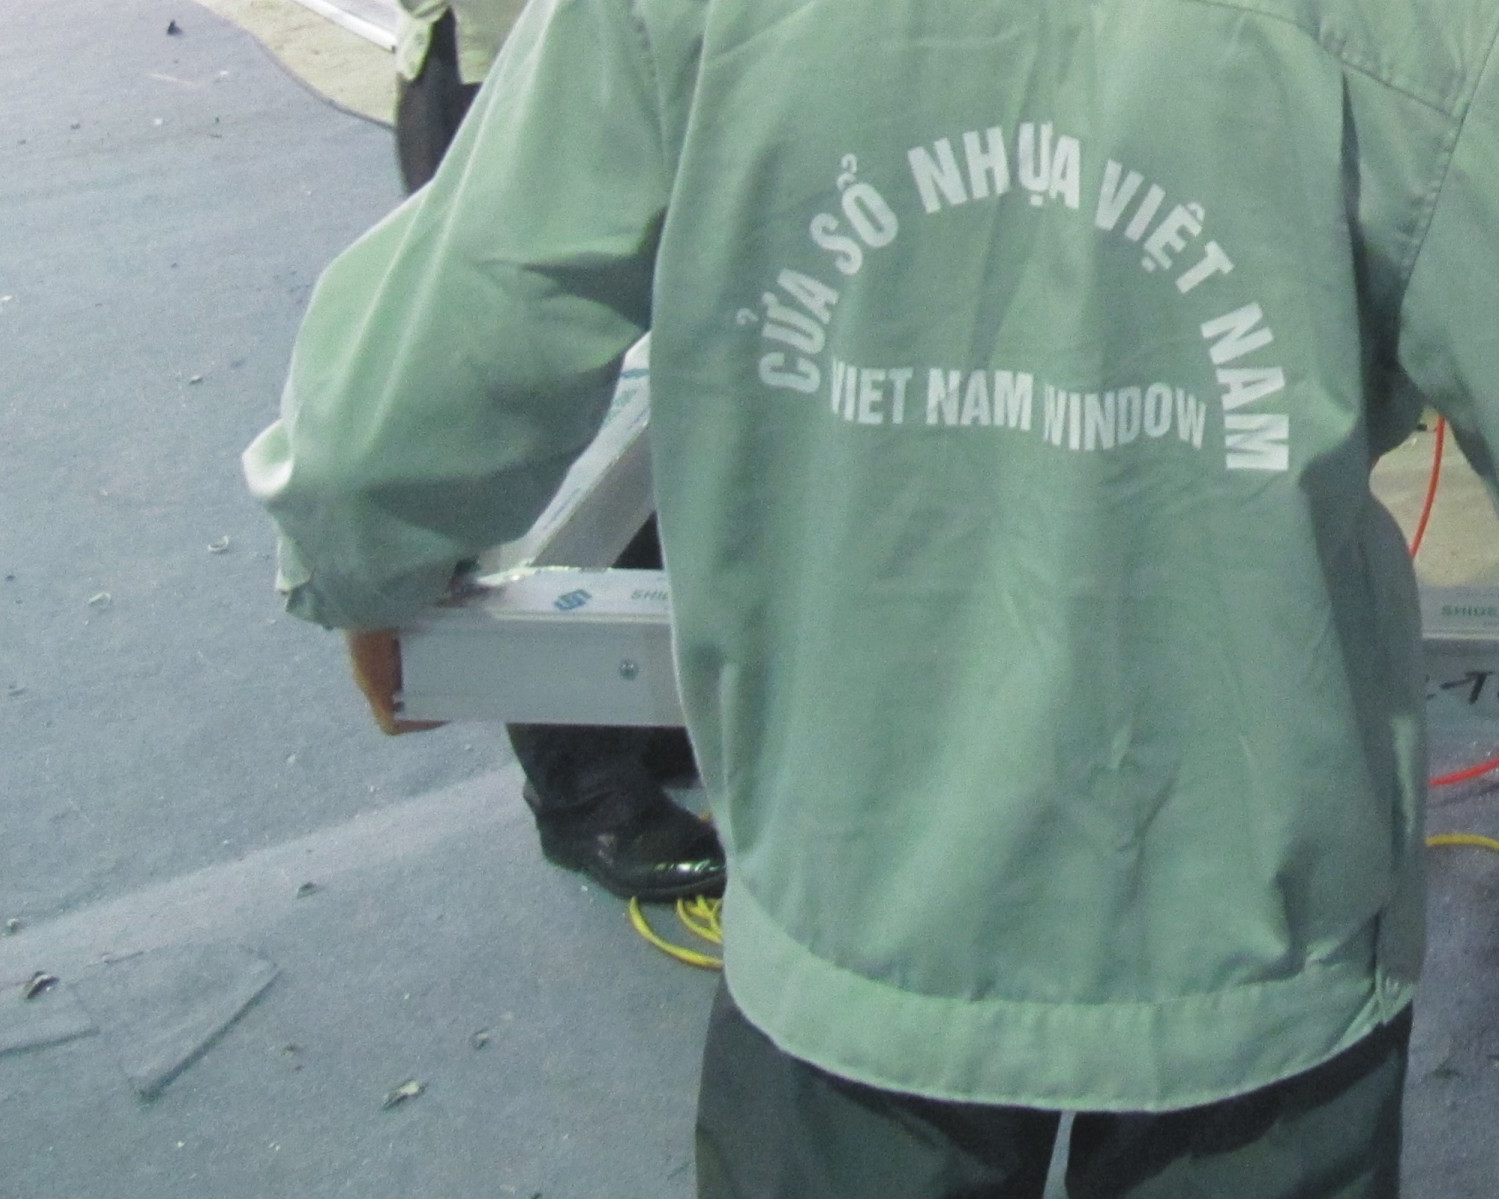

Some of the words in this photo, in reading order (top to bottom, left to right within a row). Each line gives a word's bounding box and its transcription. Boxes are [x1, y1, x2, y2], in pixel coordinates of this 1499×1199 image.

[735, 267, 840, 394] CỬA
[808, 152, 900, 276] SỔ
[906, 120, 1081, 215] NHỰA
[1094, 158, 1235, 295] VIỆT
[1200, 301, 1290, 471] NAM
[830, 355, 914, 425] VIET
[925, 367, 1034, 431] NAM
[1042, 382, 1206, 452] WINDOW
